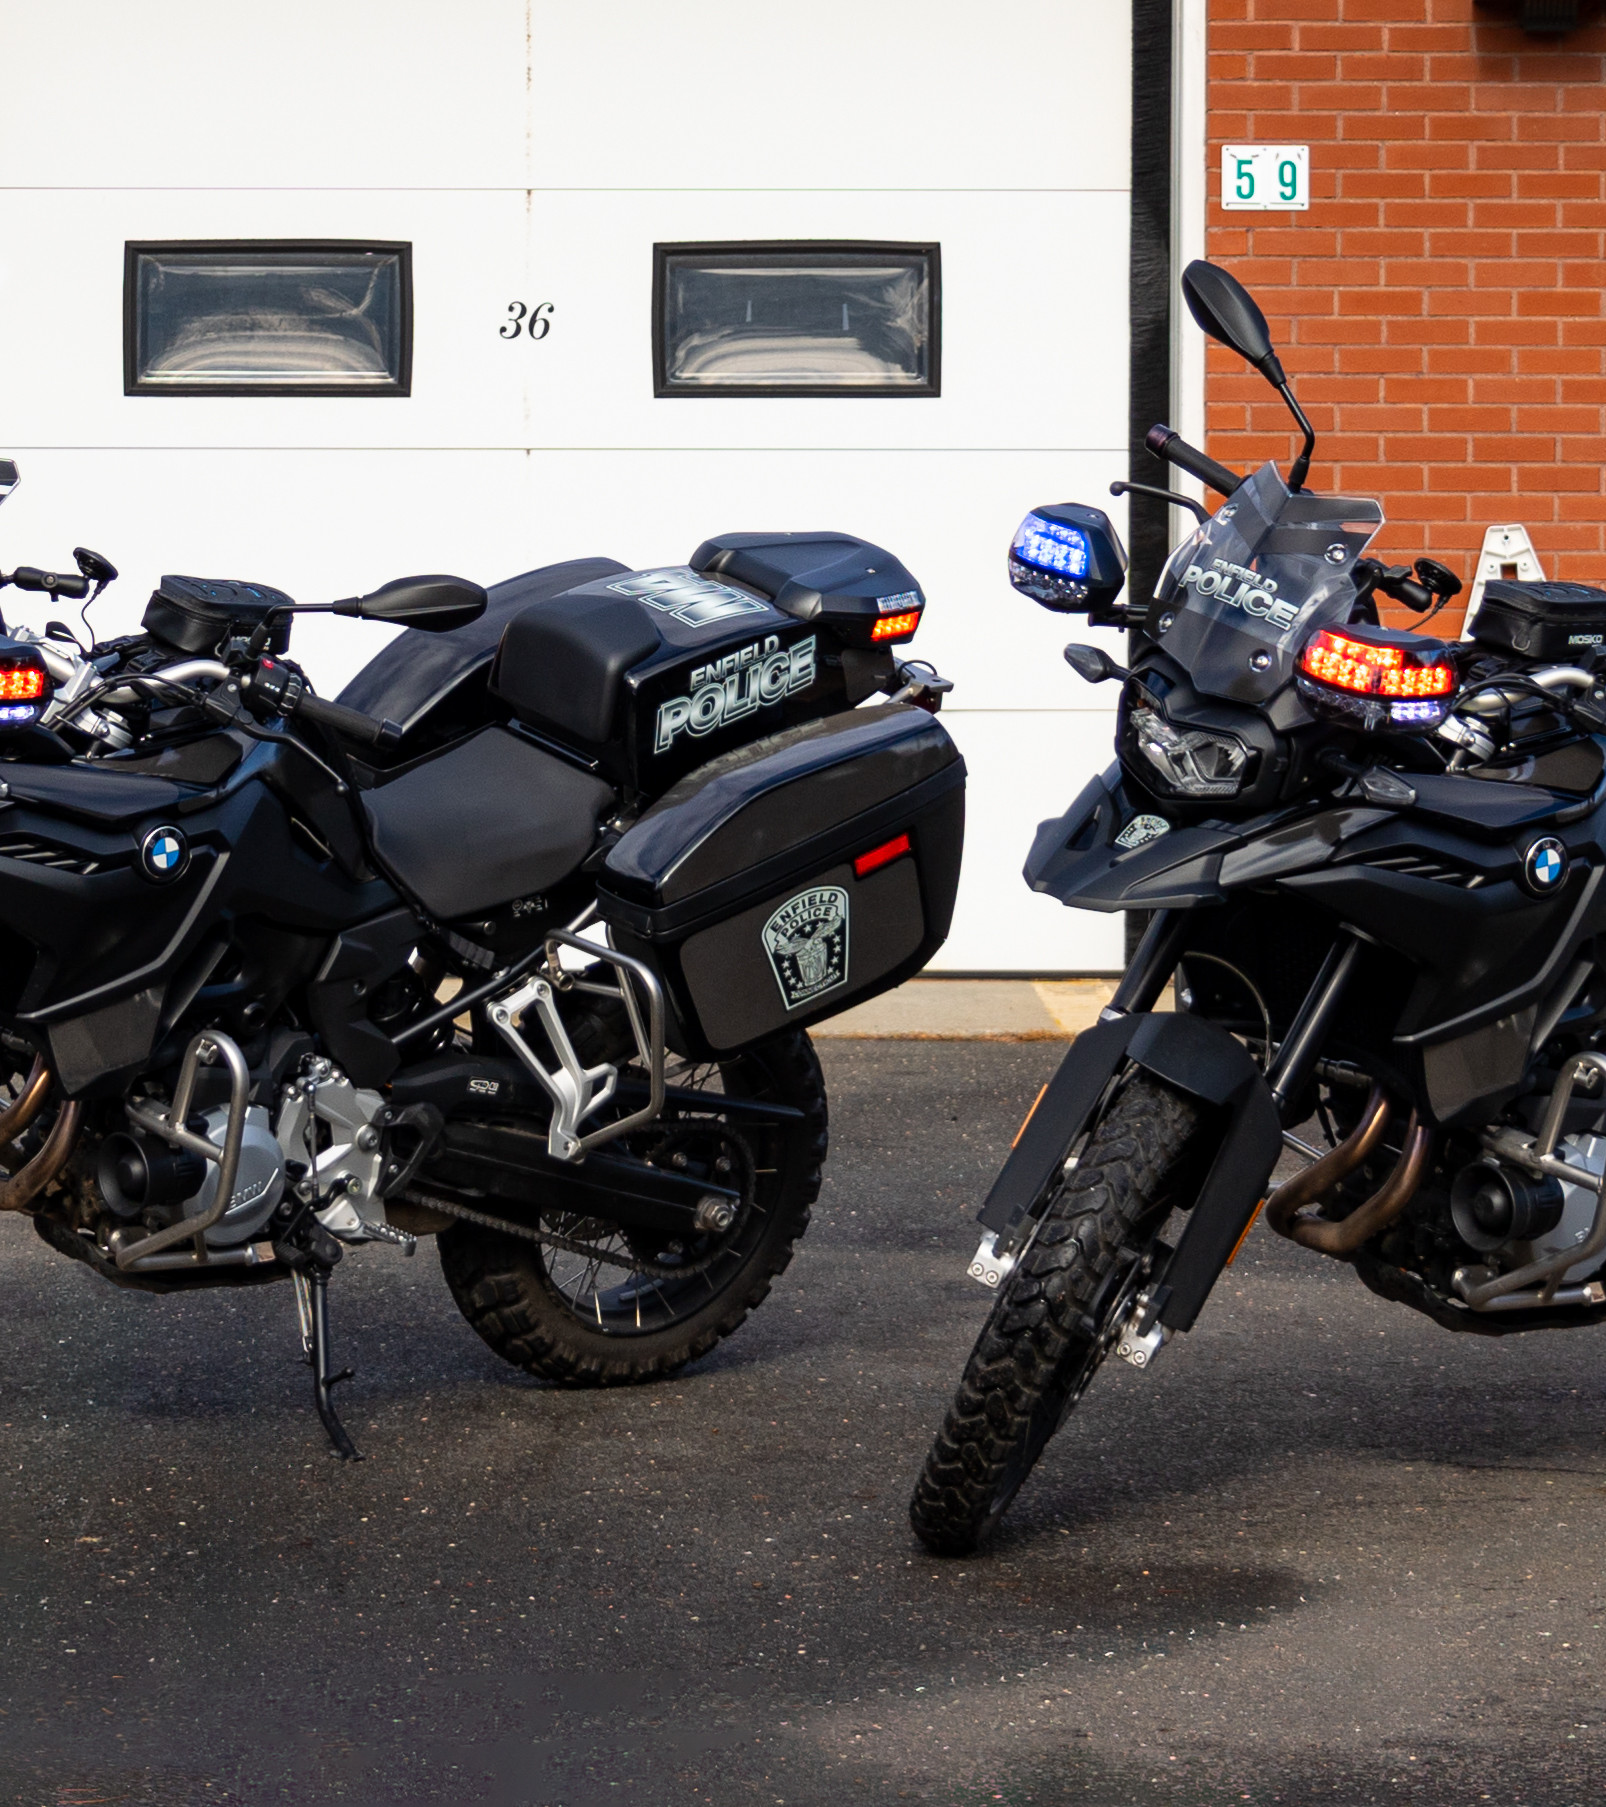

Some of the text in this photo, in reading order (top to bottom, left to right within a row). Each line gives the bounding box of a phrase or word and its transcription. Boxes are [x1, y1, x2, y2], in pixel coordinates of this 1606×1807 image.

[499, 300, 555, 340] 36
[1209, 558, 1279, 594] ENFIELD
[1178, 564, 1300, 631] POLICE
[1567, 634, 1604, 645] MOSKO
[690, 634, 780, 692] ENFIELD
[654, 634, 817, 755] POLICE
[769, 892, 839, 933] ENFIELD
[780, 906, 833, 938] POLICE
